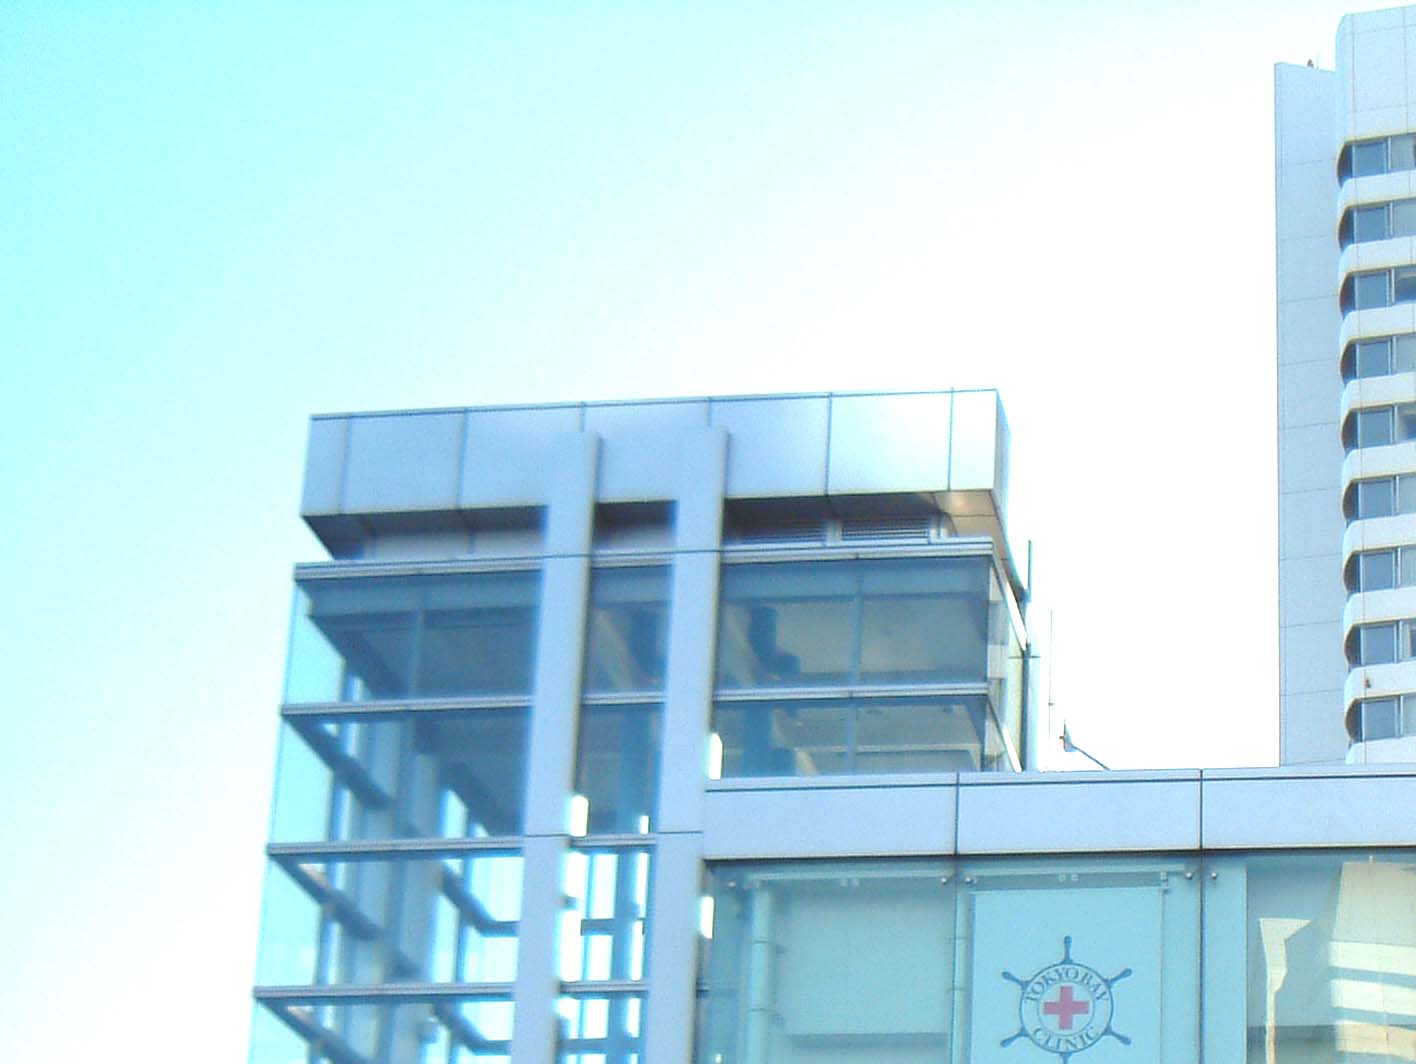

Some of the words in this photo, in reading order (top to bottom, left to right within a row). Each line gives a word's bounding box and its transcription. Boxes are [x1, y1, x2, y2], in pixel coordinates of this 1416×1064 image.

[1024, 966, 1079, 1005] TOKYO
[1079, 970, 1110, 1004] BAY
[1032, 1024, 1101, 1053] CLINIC
